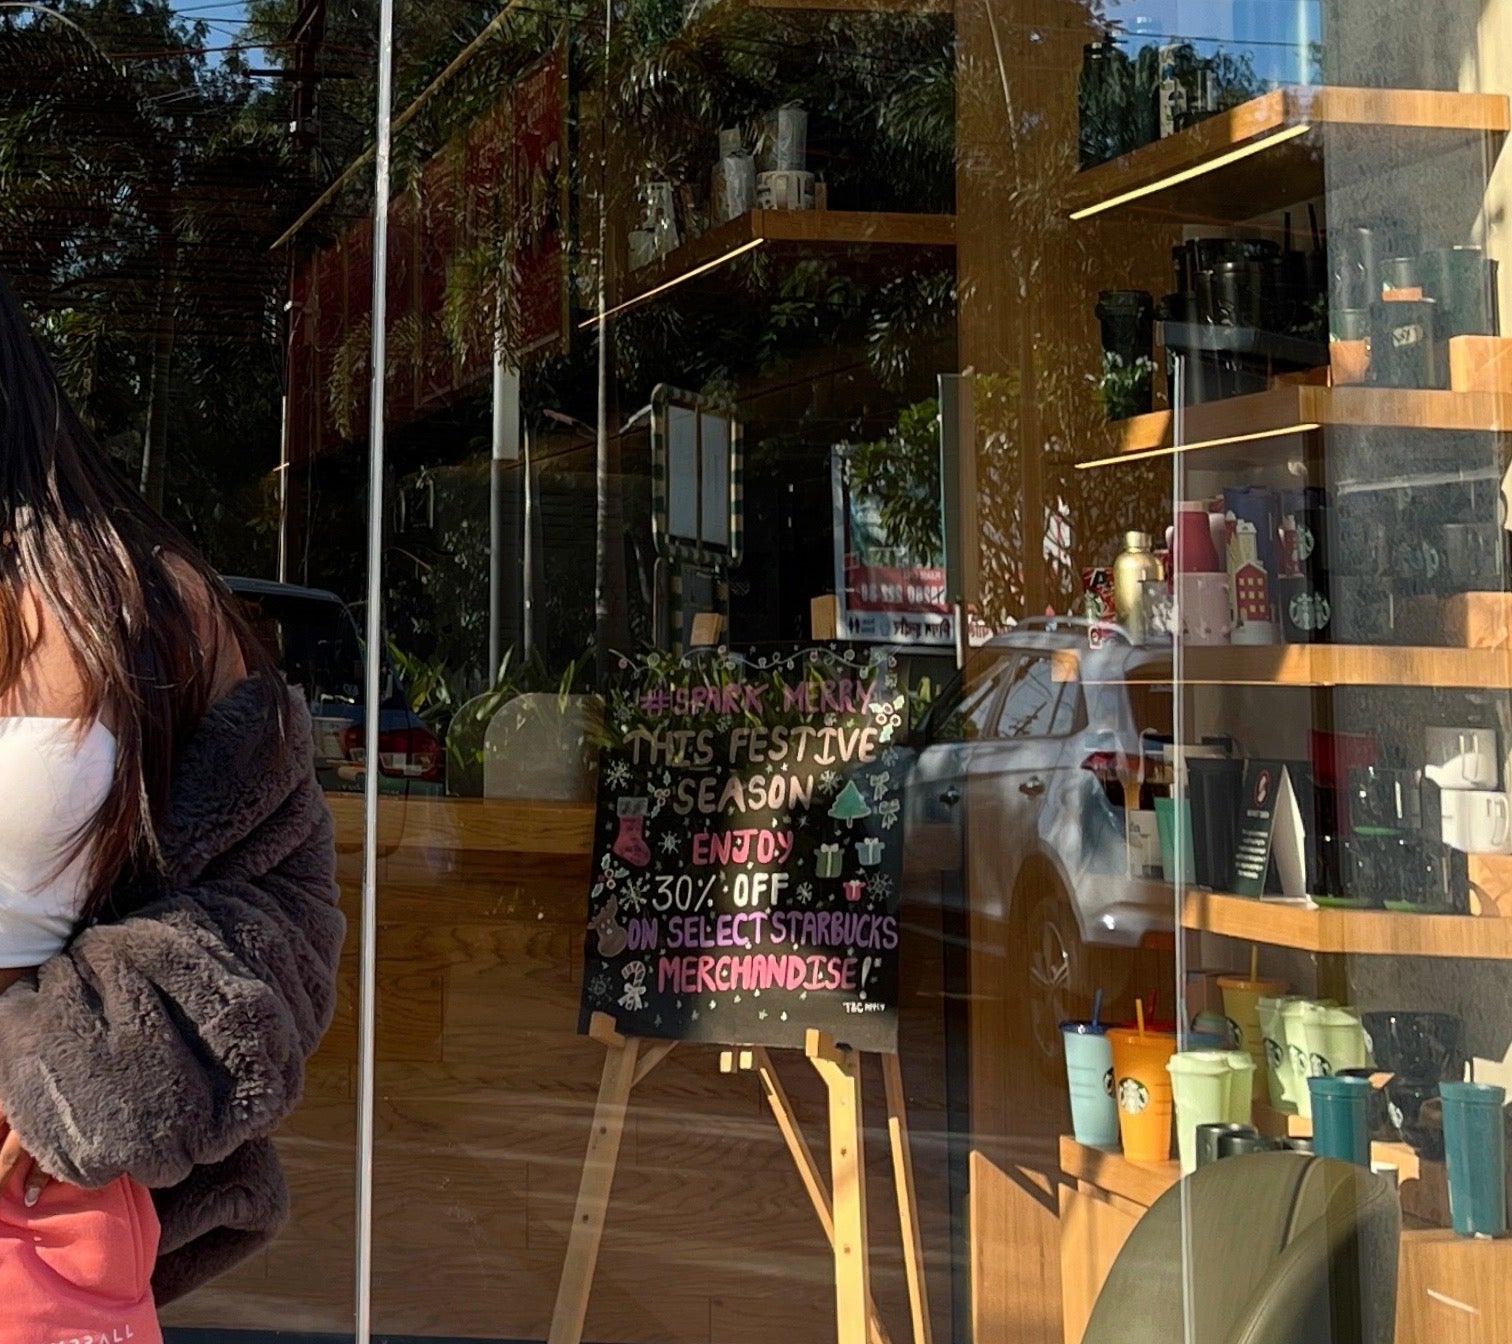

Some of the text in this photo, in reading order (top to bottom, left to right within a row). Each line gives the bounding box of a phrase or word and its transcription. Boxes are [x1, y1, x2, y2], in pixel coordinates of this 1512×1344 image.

[783, 679, 876, 715] MERRY
[623, 725, 879, 766] THIS FESTIVE
[673, 774, 814, 816] SEASON
[693, 829, 794, 866] ENJOY
[651, 872, 790, 913] 30% OFF
[627, 911, 899, 951] ON SELECT STARBUCKS
[658, 953, 872, 1001] MERCHANDISE!
